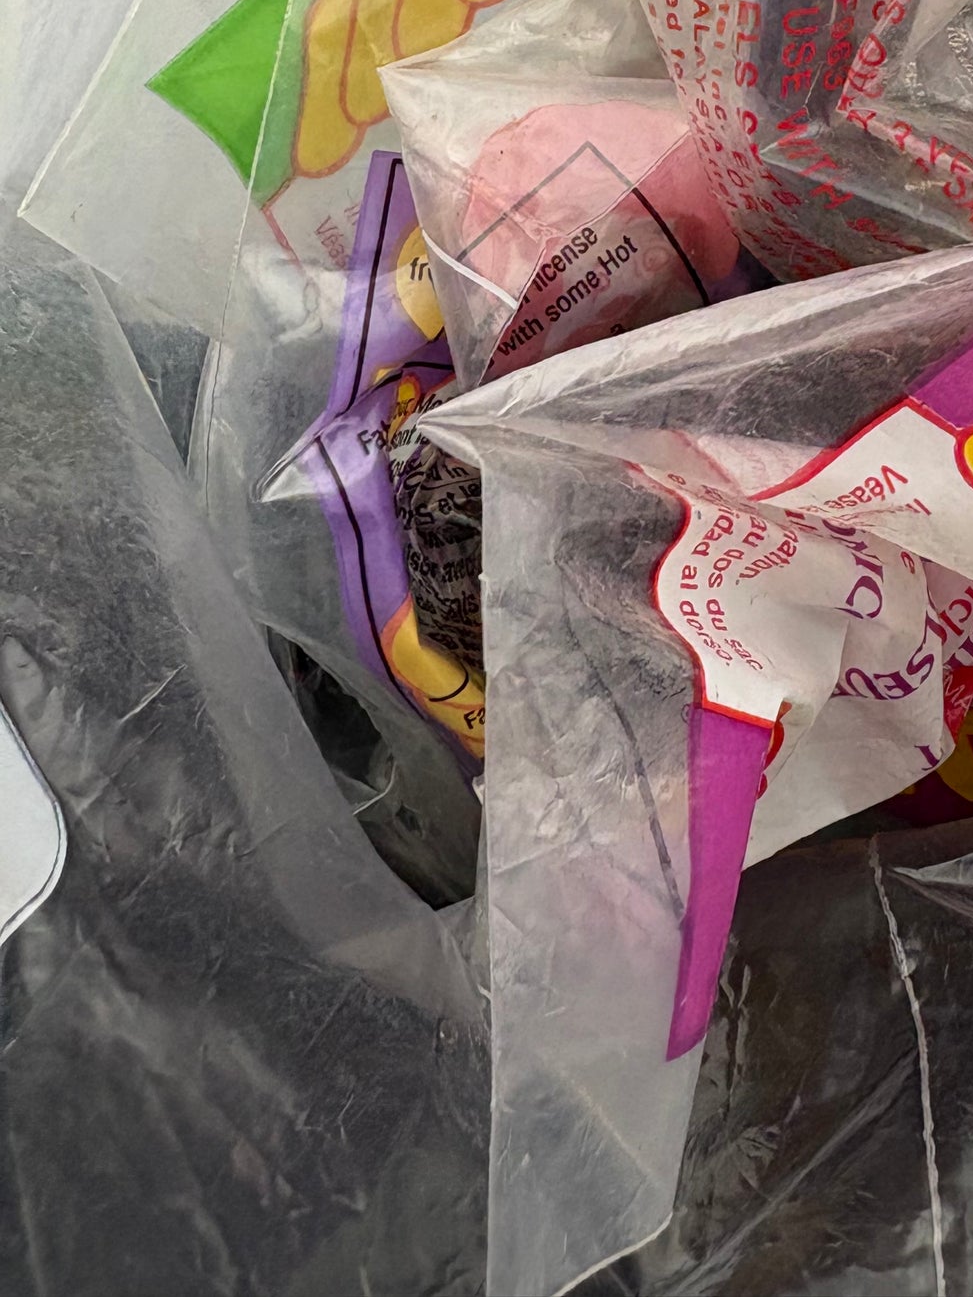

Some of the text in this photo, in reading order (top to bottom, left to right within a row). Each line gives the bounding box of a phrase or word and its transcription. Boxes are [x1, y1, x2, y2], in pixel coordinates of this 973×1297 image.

[779, 7, 821, 100] USE
[497, 315, 544, 358] with
[545, 266, 600, 323] some
[598, 234, 639, 277] Hot
[680, 565, 699, 590] al
[707, 548, 745, 589] dos
[706, 598, 728, 632] du
